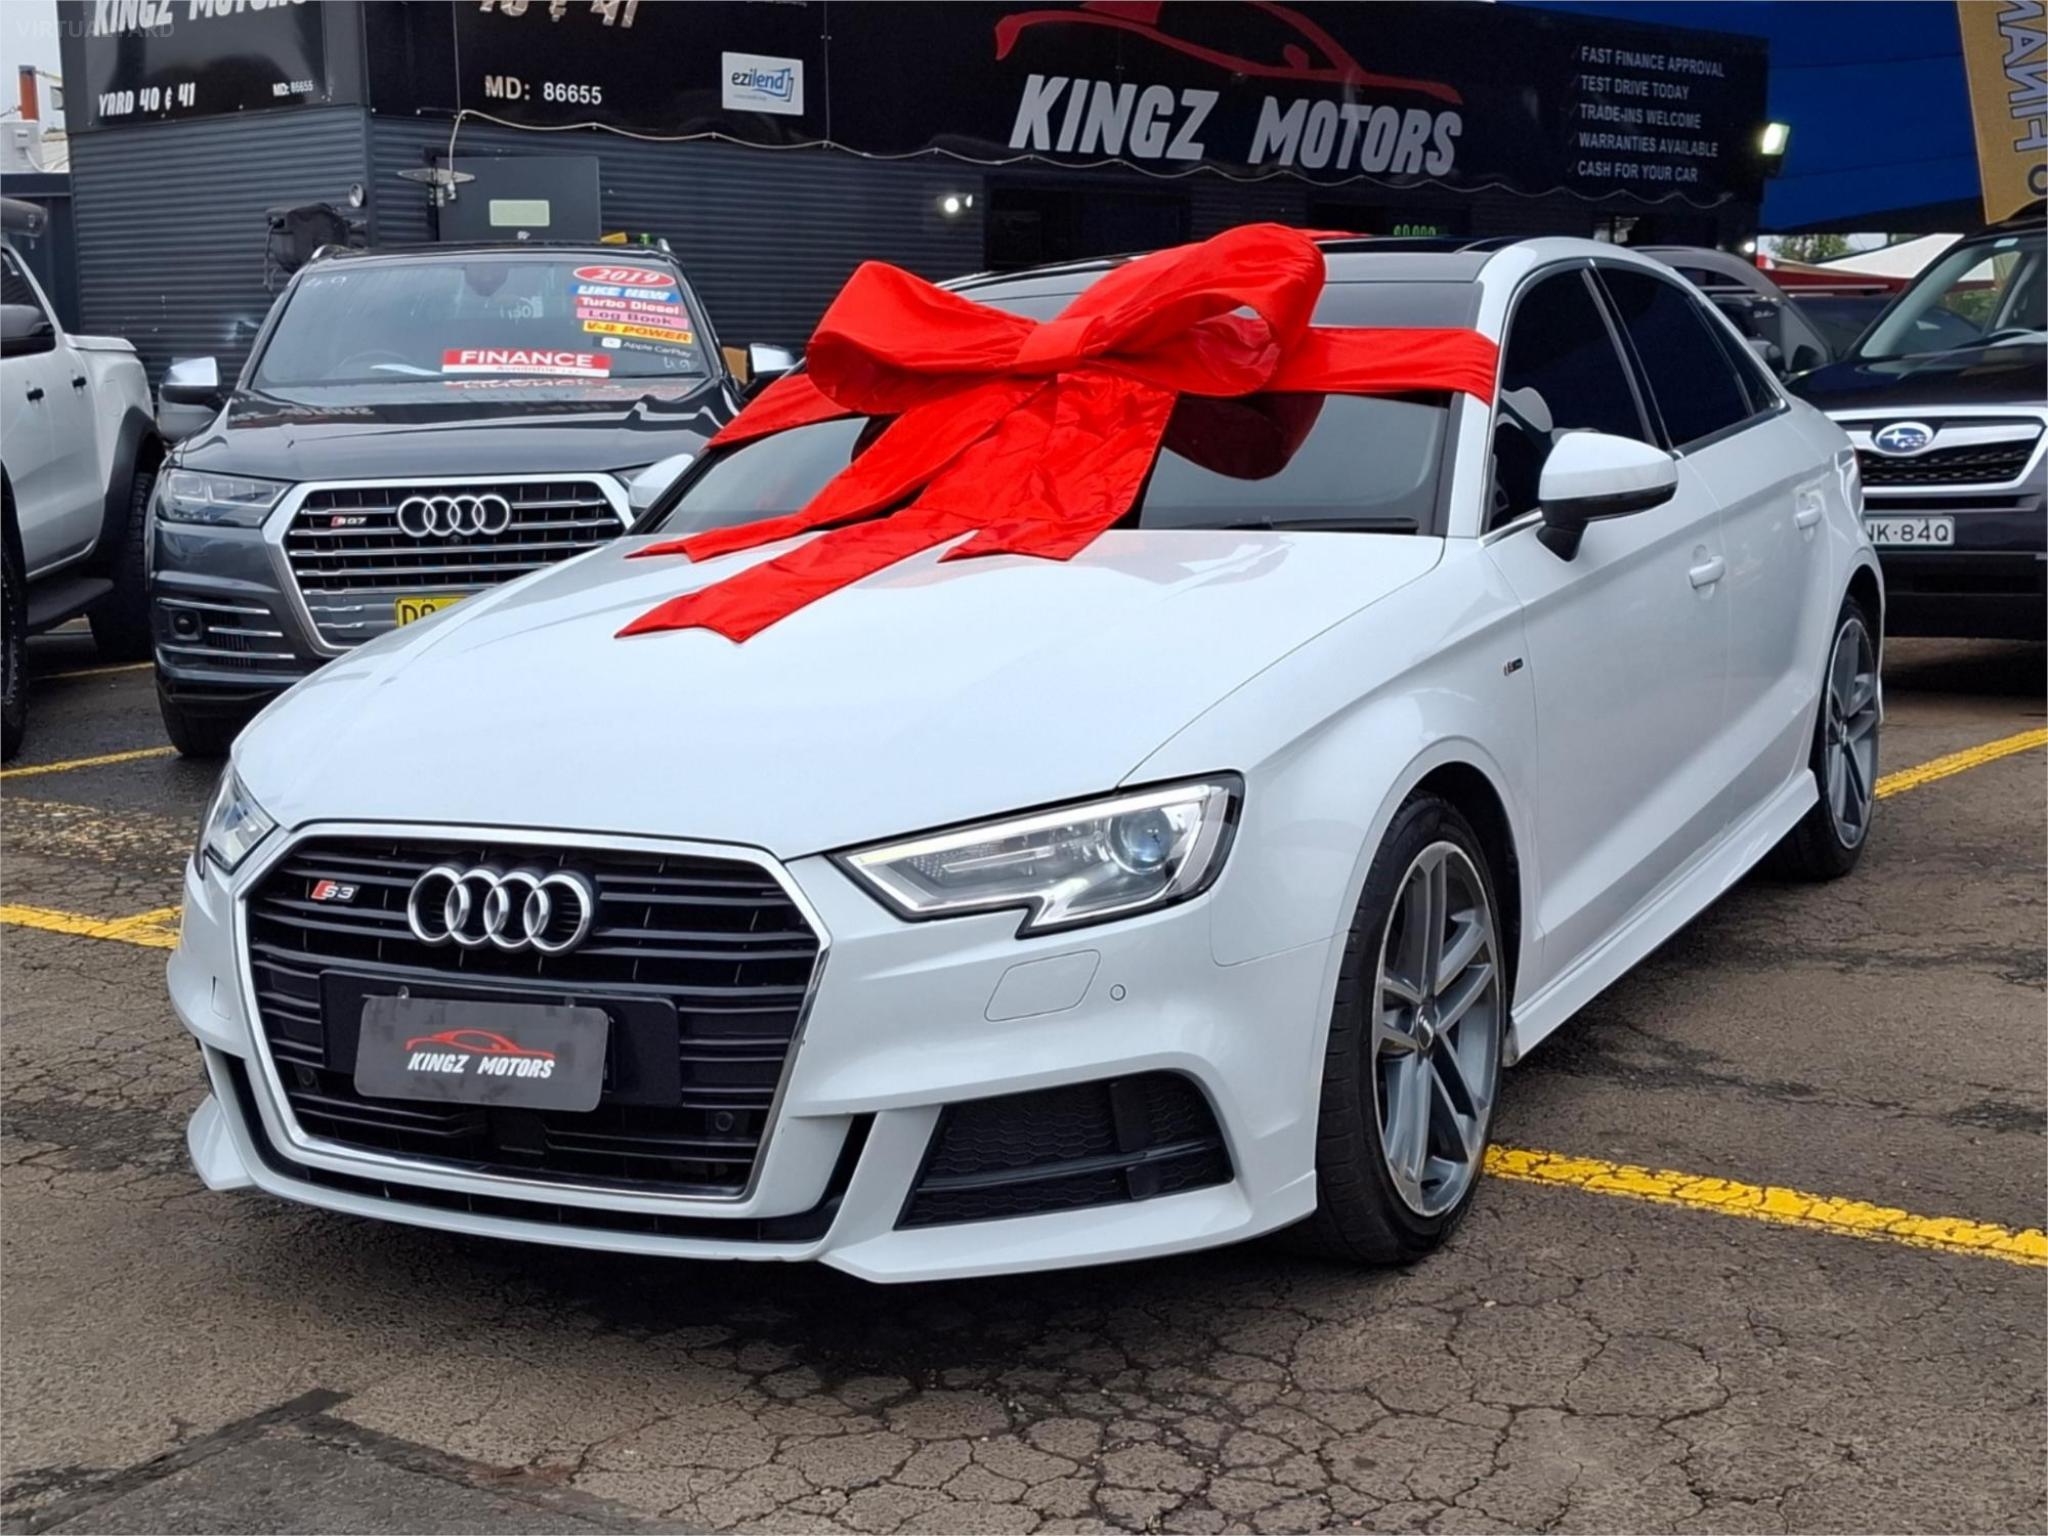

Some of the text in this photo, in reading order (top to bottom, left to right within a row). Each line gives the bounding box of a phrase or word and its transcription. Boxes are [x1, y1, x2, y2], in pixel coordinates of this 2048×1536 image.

[1581, 46, 1725, 77] FAST FINANCE APPROVAL
[485, 75, 602, 105] MD: 86655
[731, 68, 784, 90] ezilend
[1581, 75, 1689, 100] TEST DRIVE TODAY
[98, 90, 134, 117] YARD
[139, 86, 160, 112] 40
[178, 82, 196, 107] 41
[1009, 73, 1462, 176] KINGZ MOTORS
[1580, 103, 1701, 129] TRADE-INS WELCOME
[1579, 132, 1718, 157] WARRANTIES AVAILABLE
[1577, 161, 1698, 182] CASH FOR YOUR CAR
[594, 269, 659, 283] 2019
[577, 285, 671, 300] LIKE NEW
[581, 297, 679, 314] Turbo Diesel
[588, 310, 673, 325] Log Book
[622, 326, 689, 341] POWER
[459, 350, 593, 367] FINANCE
[406, 1052, 555, 1078] KINGZ MOTORS
